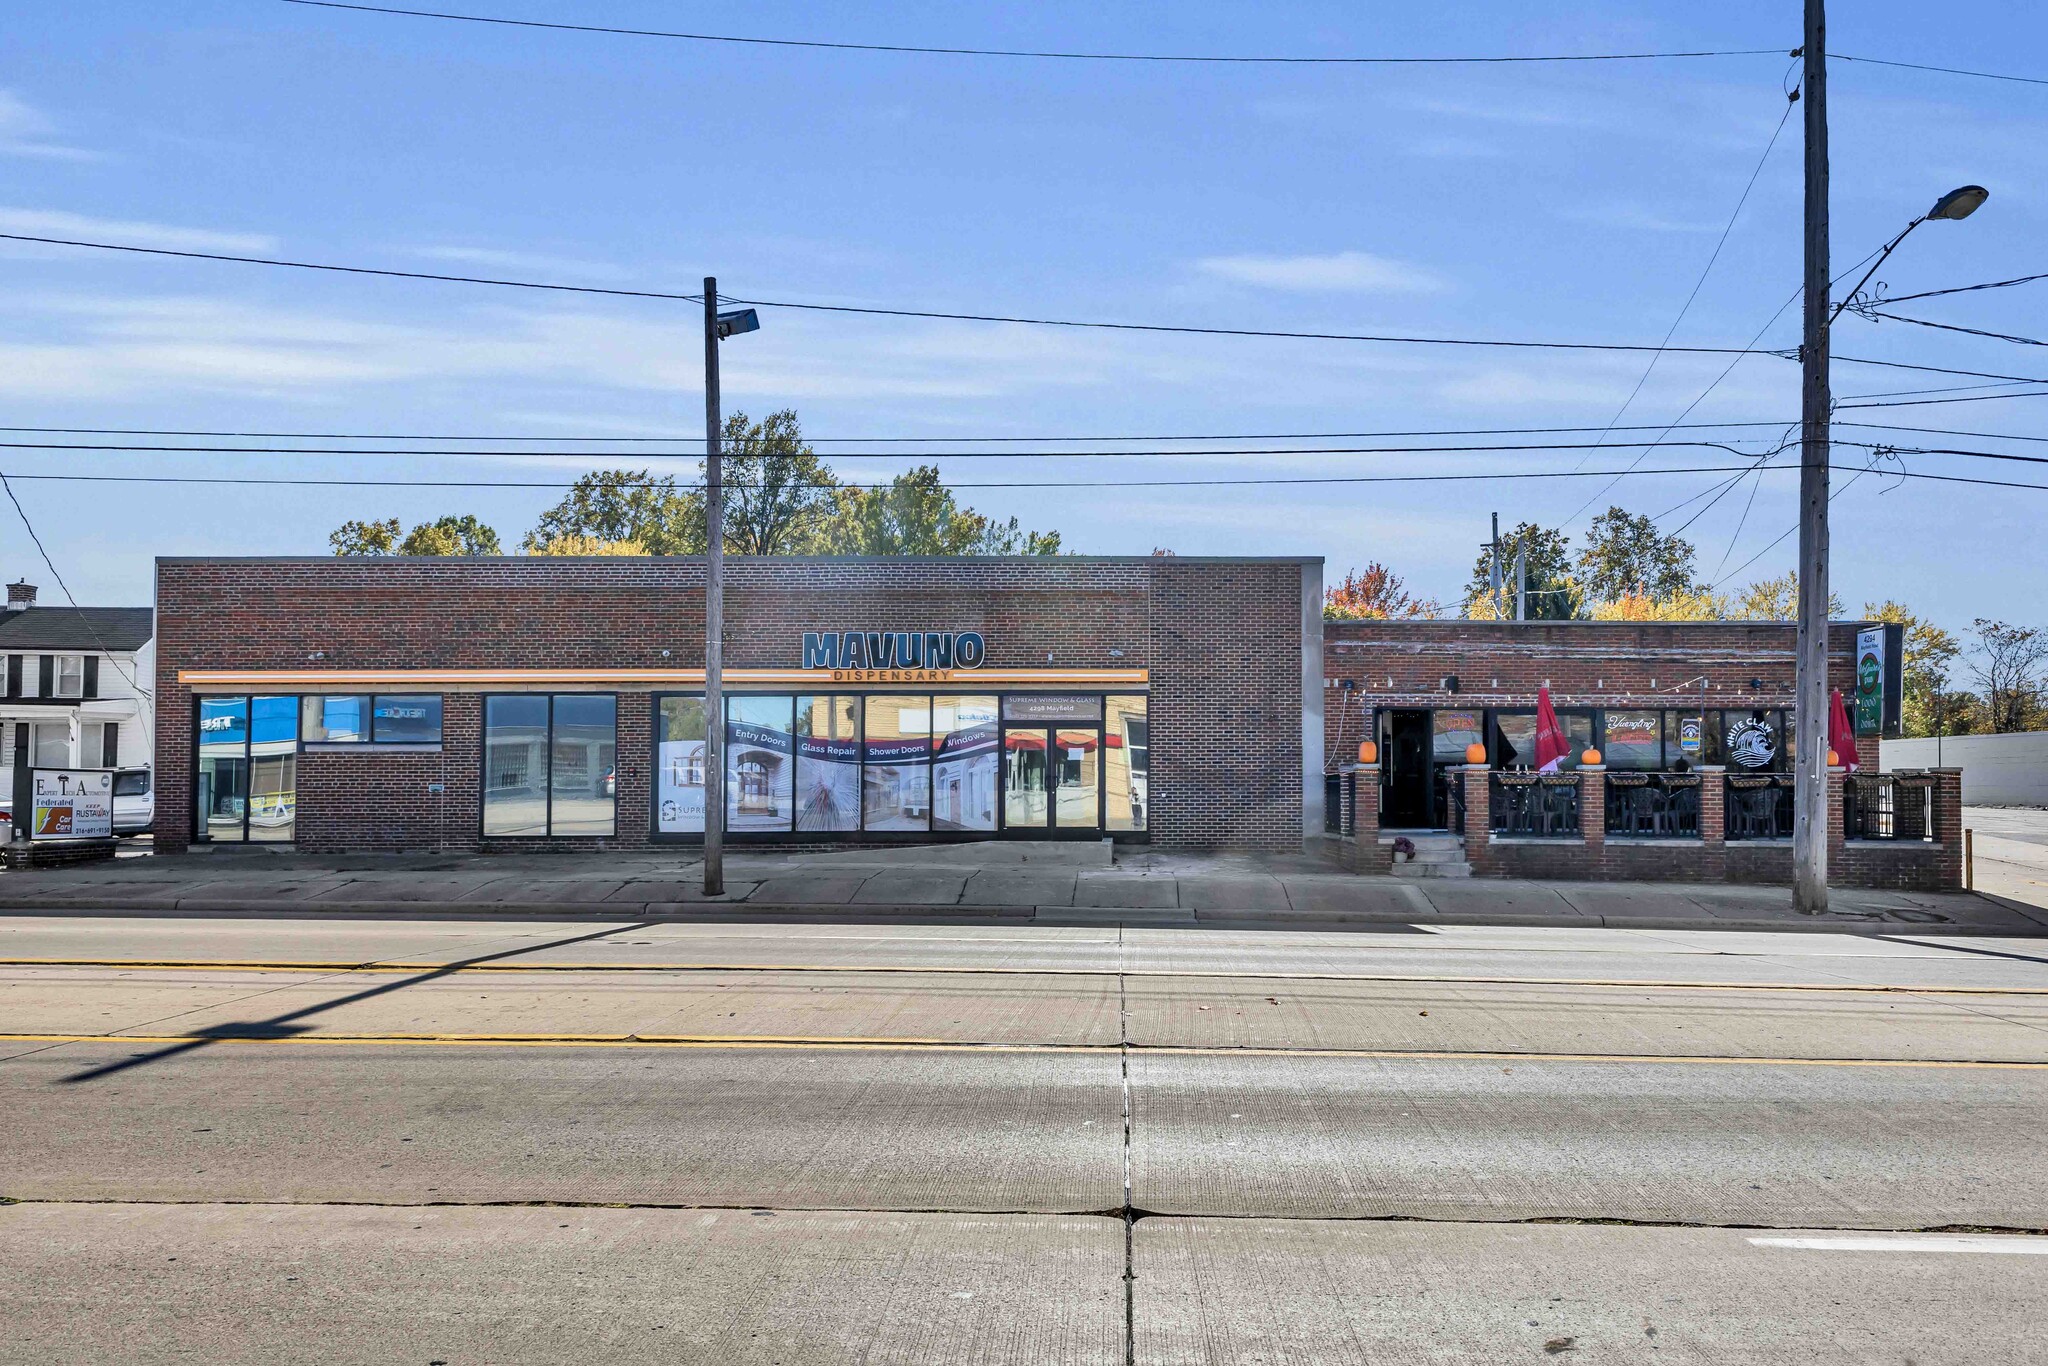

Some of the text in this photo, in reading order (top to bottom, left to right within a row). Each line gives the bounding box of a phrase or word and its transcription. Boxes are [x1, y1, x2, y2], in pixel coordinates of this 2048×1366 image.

[802, 631, 985, 670] MAVUNO
[834, 671, 950, 681] DISPENSARY
[1046, 705, 1074, 713] Mayfield
[1607, 715, 1656, 730] Yuengling
[735, 729, 786, 747] Entry Doors
[1727, 717, 1773, 747] WHITE CLAW
[947, 731, 986, 747] Windows
[801, 742, 856, 756] Glass Repair
[869, 745, 925, 756] Shower Doors
[678, 806, 706, 814] SUPRE
[59, 815, 71, 823] Car
[55, 823, 71, 831] Care
